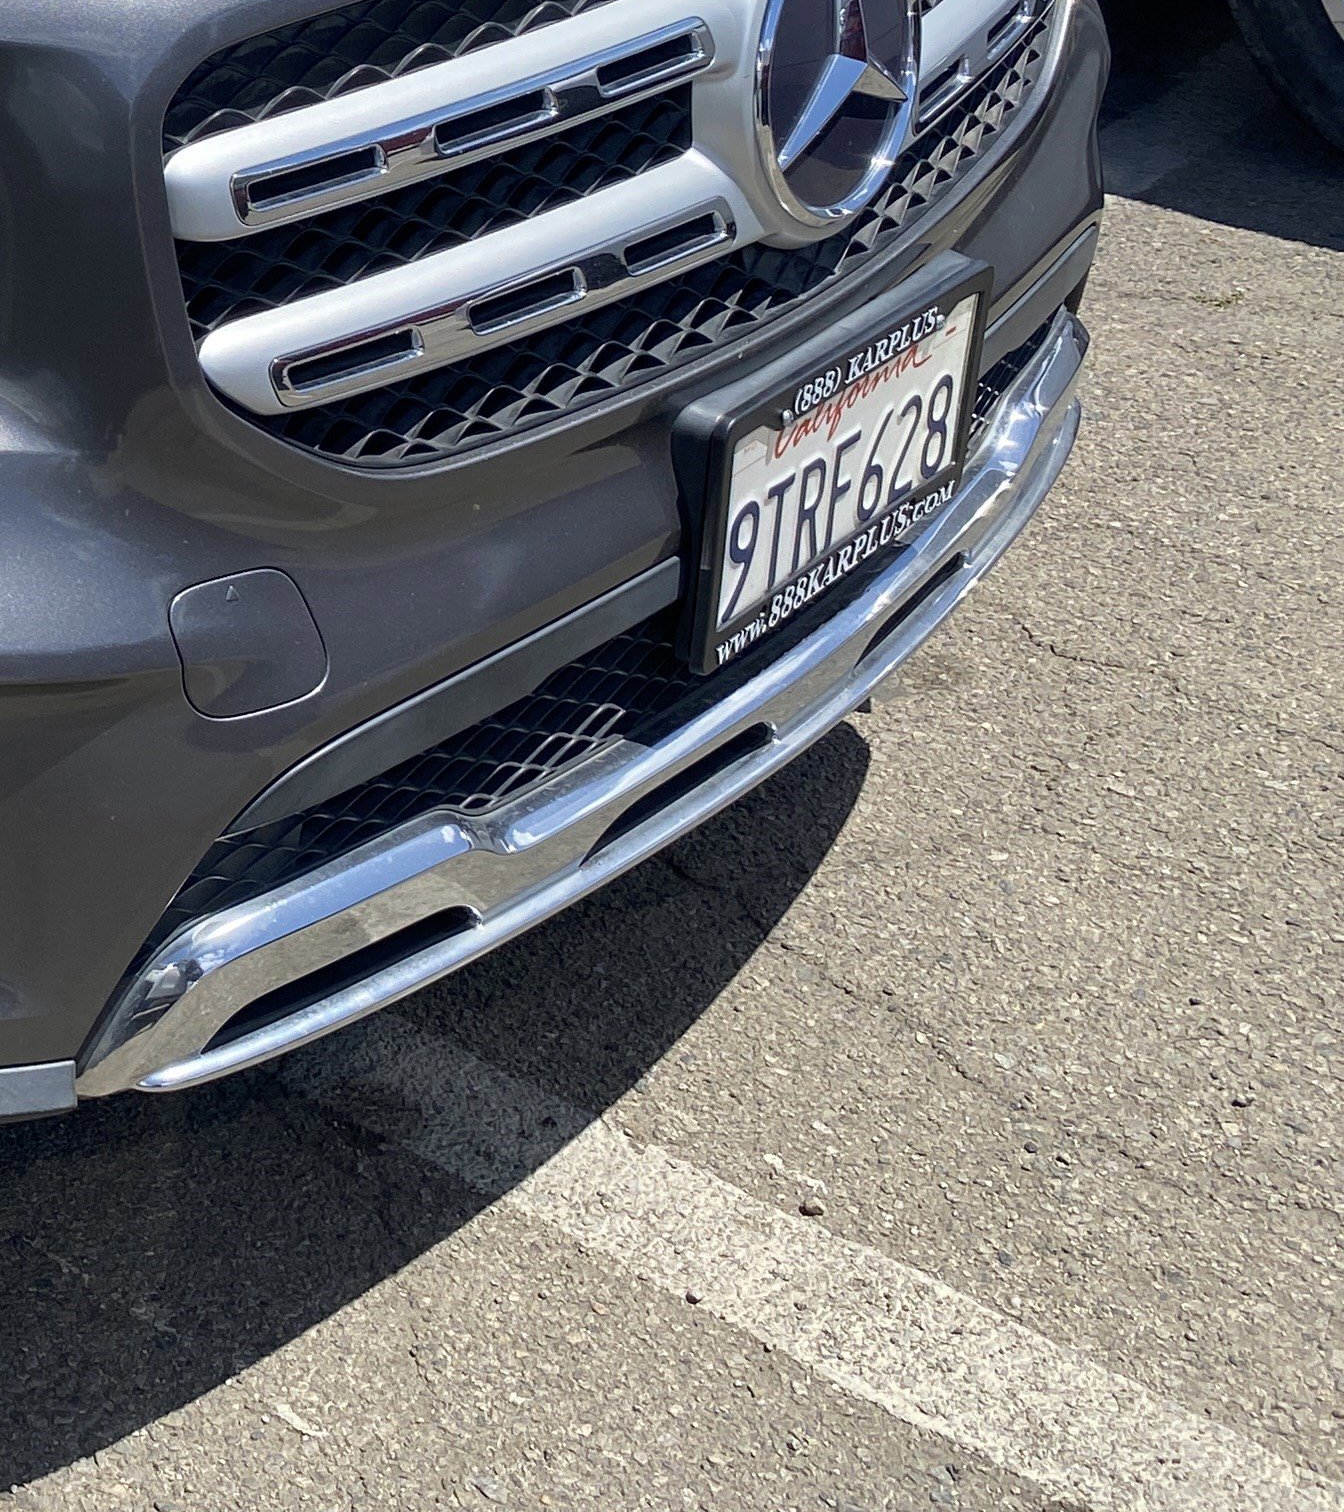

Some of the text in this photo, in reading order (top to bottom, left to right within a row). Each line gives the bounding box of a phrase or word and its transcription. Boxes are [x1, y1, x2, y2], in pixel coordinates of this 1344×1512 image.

[775, 345, 933, 459] California
[794, 306, 939, 415] (888) KARPLUS
[720, 373, 954, 624] 9TRF628
